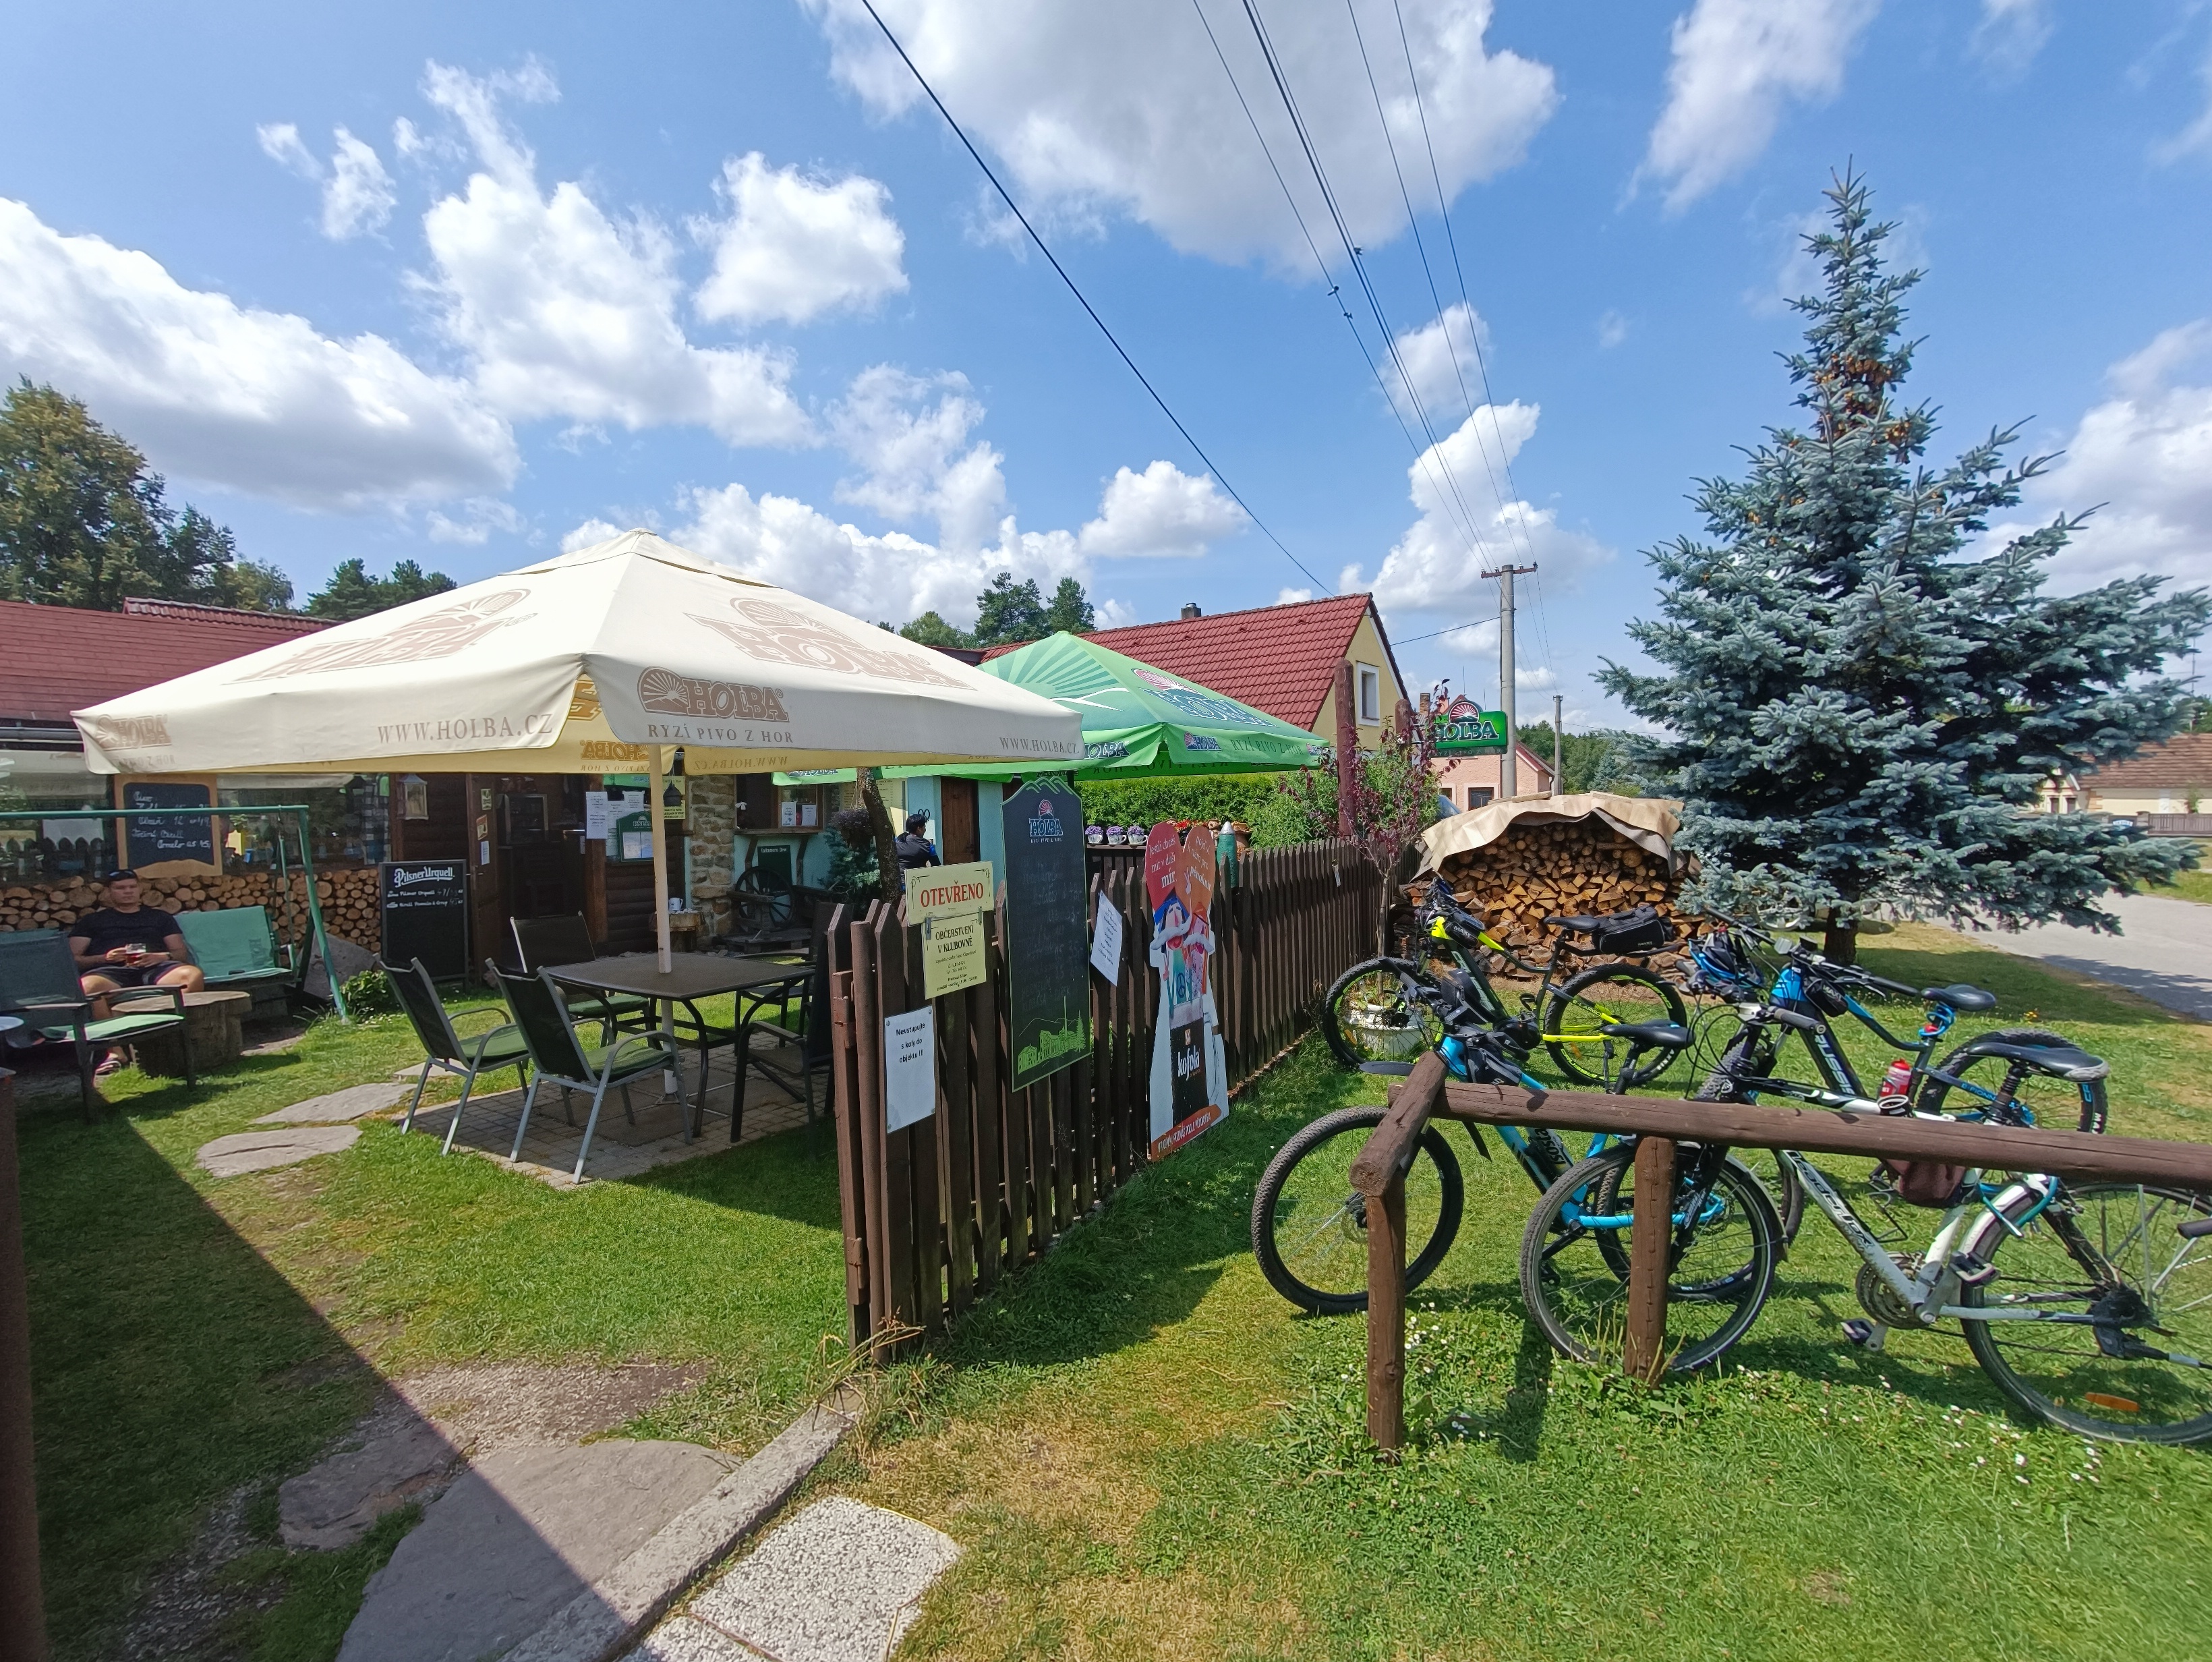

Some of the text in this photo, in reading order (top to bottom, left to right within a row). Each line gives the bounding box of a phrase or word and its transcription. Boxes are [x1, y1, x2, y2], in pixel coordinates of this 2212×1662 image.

[682, 612, 978, 691] HOLBA
[681, 679, 789, 722] HOLBA
[116, 715, 171, 751] HOLBA
[378, 714, 553, 744] WWW.HOLBA.CZ
[647, 723, 793, 743] RYZÍ PIVO Z HOR
[999, 737, 1080, 754] WWW.HOLBA.CZ
[1194, 737, 1221, 751] HOLBA
[1231, 737, 1252, 751] RYZÍ
[1257, 741, 1276, 753] PIVO
[1279, 743, 1285, 753] Z
[1287, 745, 1304, 755] HOR
[1029, 818, 1064, 837] HOLBA
[1165, 851, 1176, 865] duši
[394, 868, 425, 888] Pilsner
[921, 880, 985, 908] OTEVŘENO
[935, 922, 974, 941] OBČERSTVENÍ
[937, 936, 973, 954] V KLUBOVNĚ
[896, 1023, 925, 1036] Nevstupujte
[905, 1040, 916, 1049] koly
[899, 1052, 918, 1064] objektu
[1177, 1045, 1200, 1081] kofola
[1815, 1034, 1855, 1095] RUSSIS
[1534, 1128, 1566, 1166] Isosta
